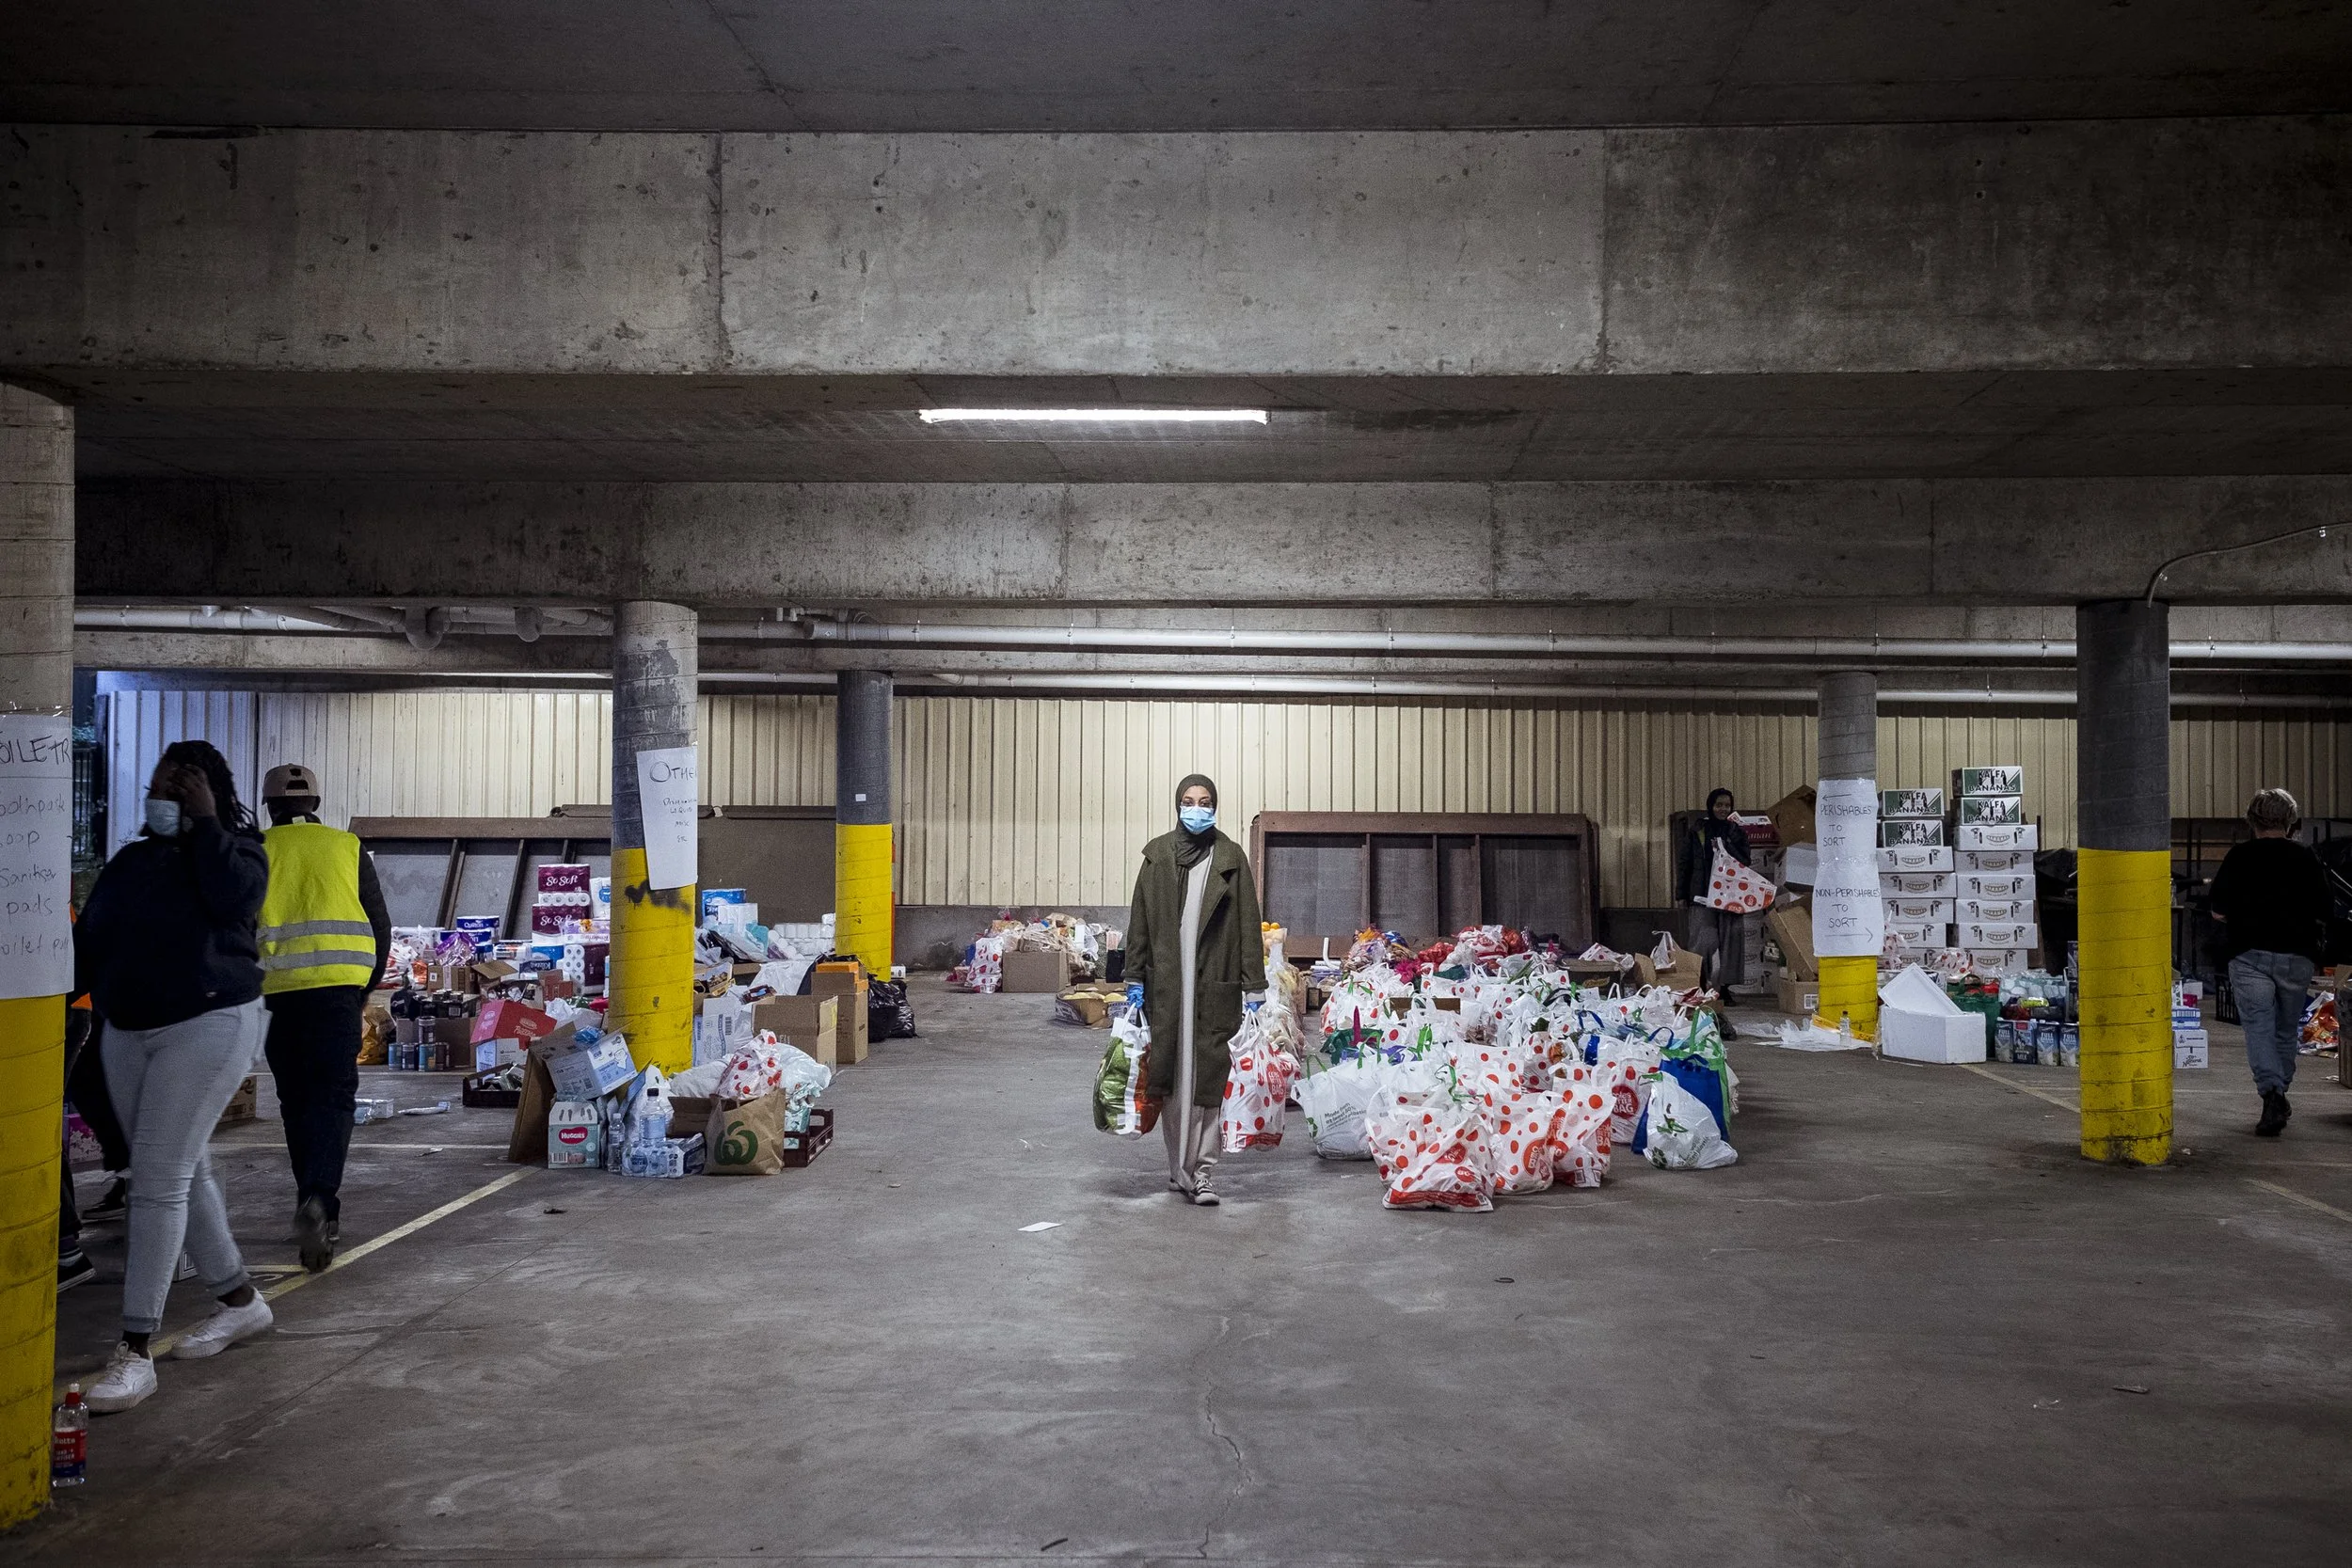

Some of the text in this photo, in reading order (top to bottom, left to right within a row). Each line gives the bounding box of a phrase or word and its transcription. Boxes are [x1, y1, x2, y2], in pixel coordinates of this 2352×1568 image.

[650, 761, 696, 783] OTHE
[1978, 769, 2007, 779] KALFA
[1899, 792, 1928, 800] KALFA
[1820, 804, 1872, 816] PERISHABLES
[1977, 800, 2006, 809] KALFA
[1899, 823, 1928, 832] KALFA
[1823, 836, 1846, 847] SORT
[1889, 836, 1937, 845] BANANAS
[546, 875, 579, 887] So Soft
[1816, 887, 1881, 898] NON-PERISHABLES
[6, 894, 53, 924] pads
[1832, 903, 1849, 912] TO
[540, 915, 552, 926] So
[1829, 917, 1858, 928] SORT
[1325, 1110, 1340, 1118] Made
